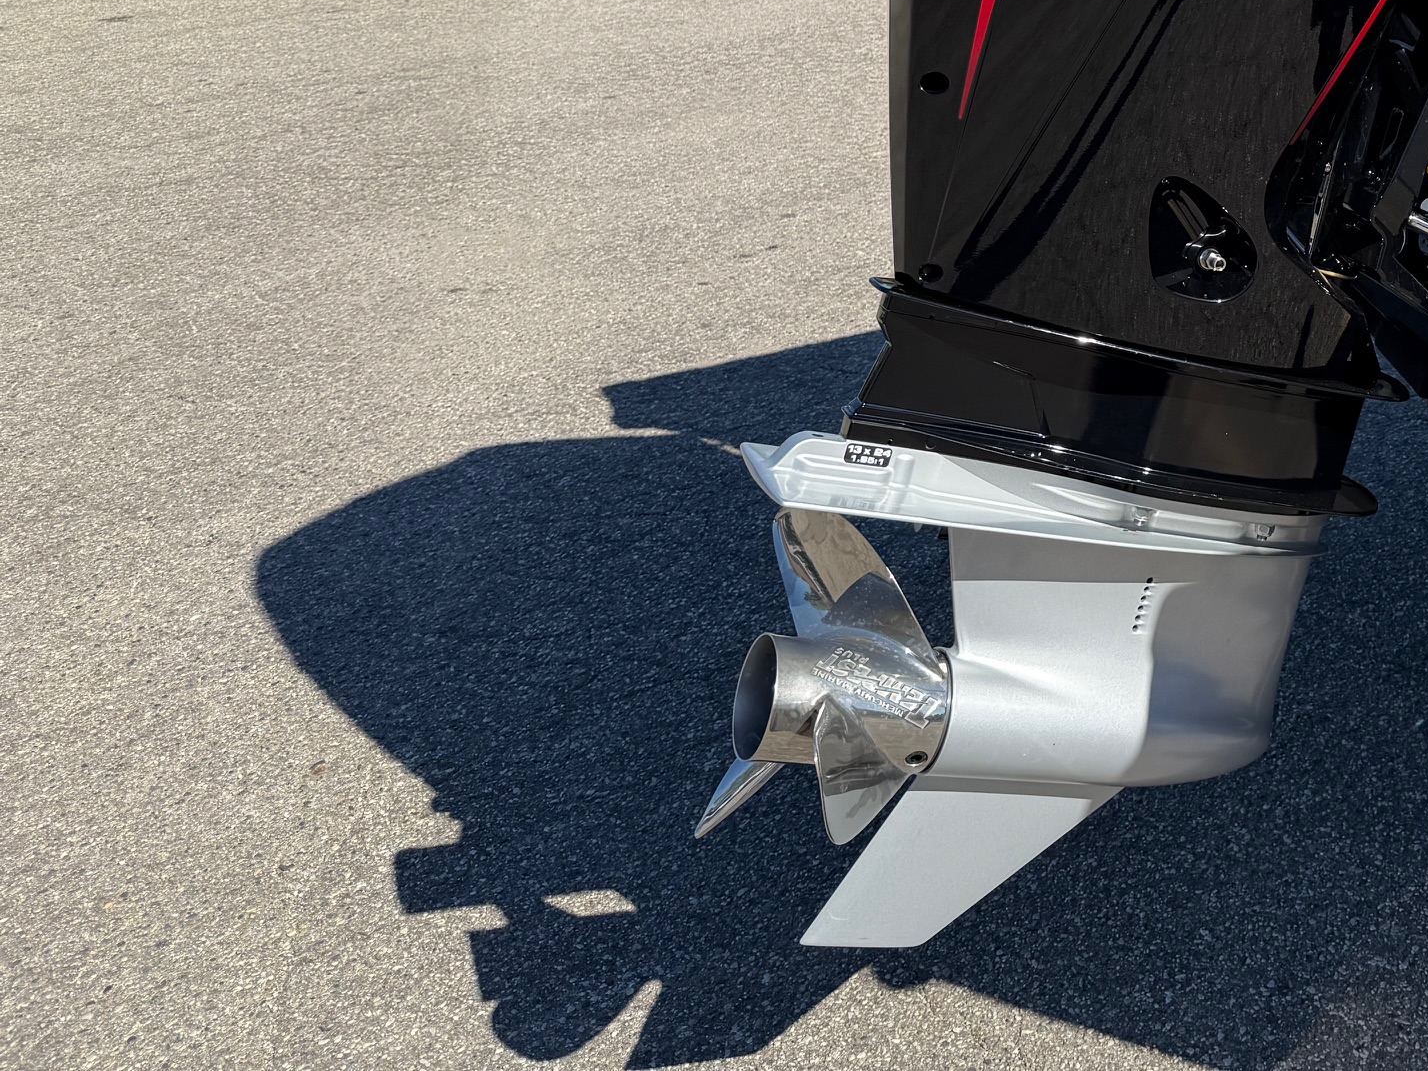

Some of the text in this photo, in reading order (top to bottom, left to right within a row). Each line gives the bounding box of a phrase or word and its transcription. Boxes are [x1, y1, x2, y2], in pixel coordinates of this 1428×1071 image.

[848, 445, 863, 454] 13
[873, 448, 892, 458] 24
[833, 647, 870, 665] PLUS
[811, 667, 905, 718] MERCURY MARINE
[814, 653, 941, 730] TEMPEST
